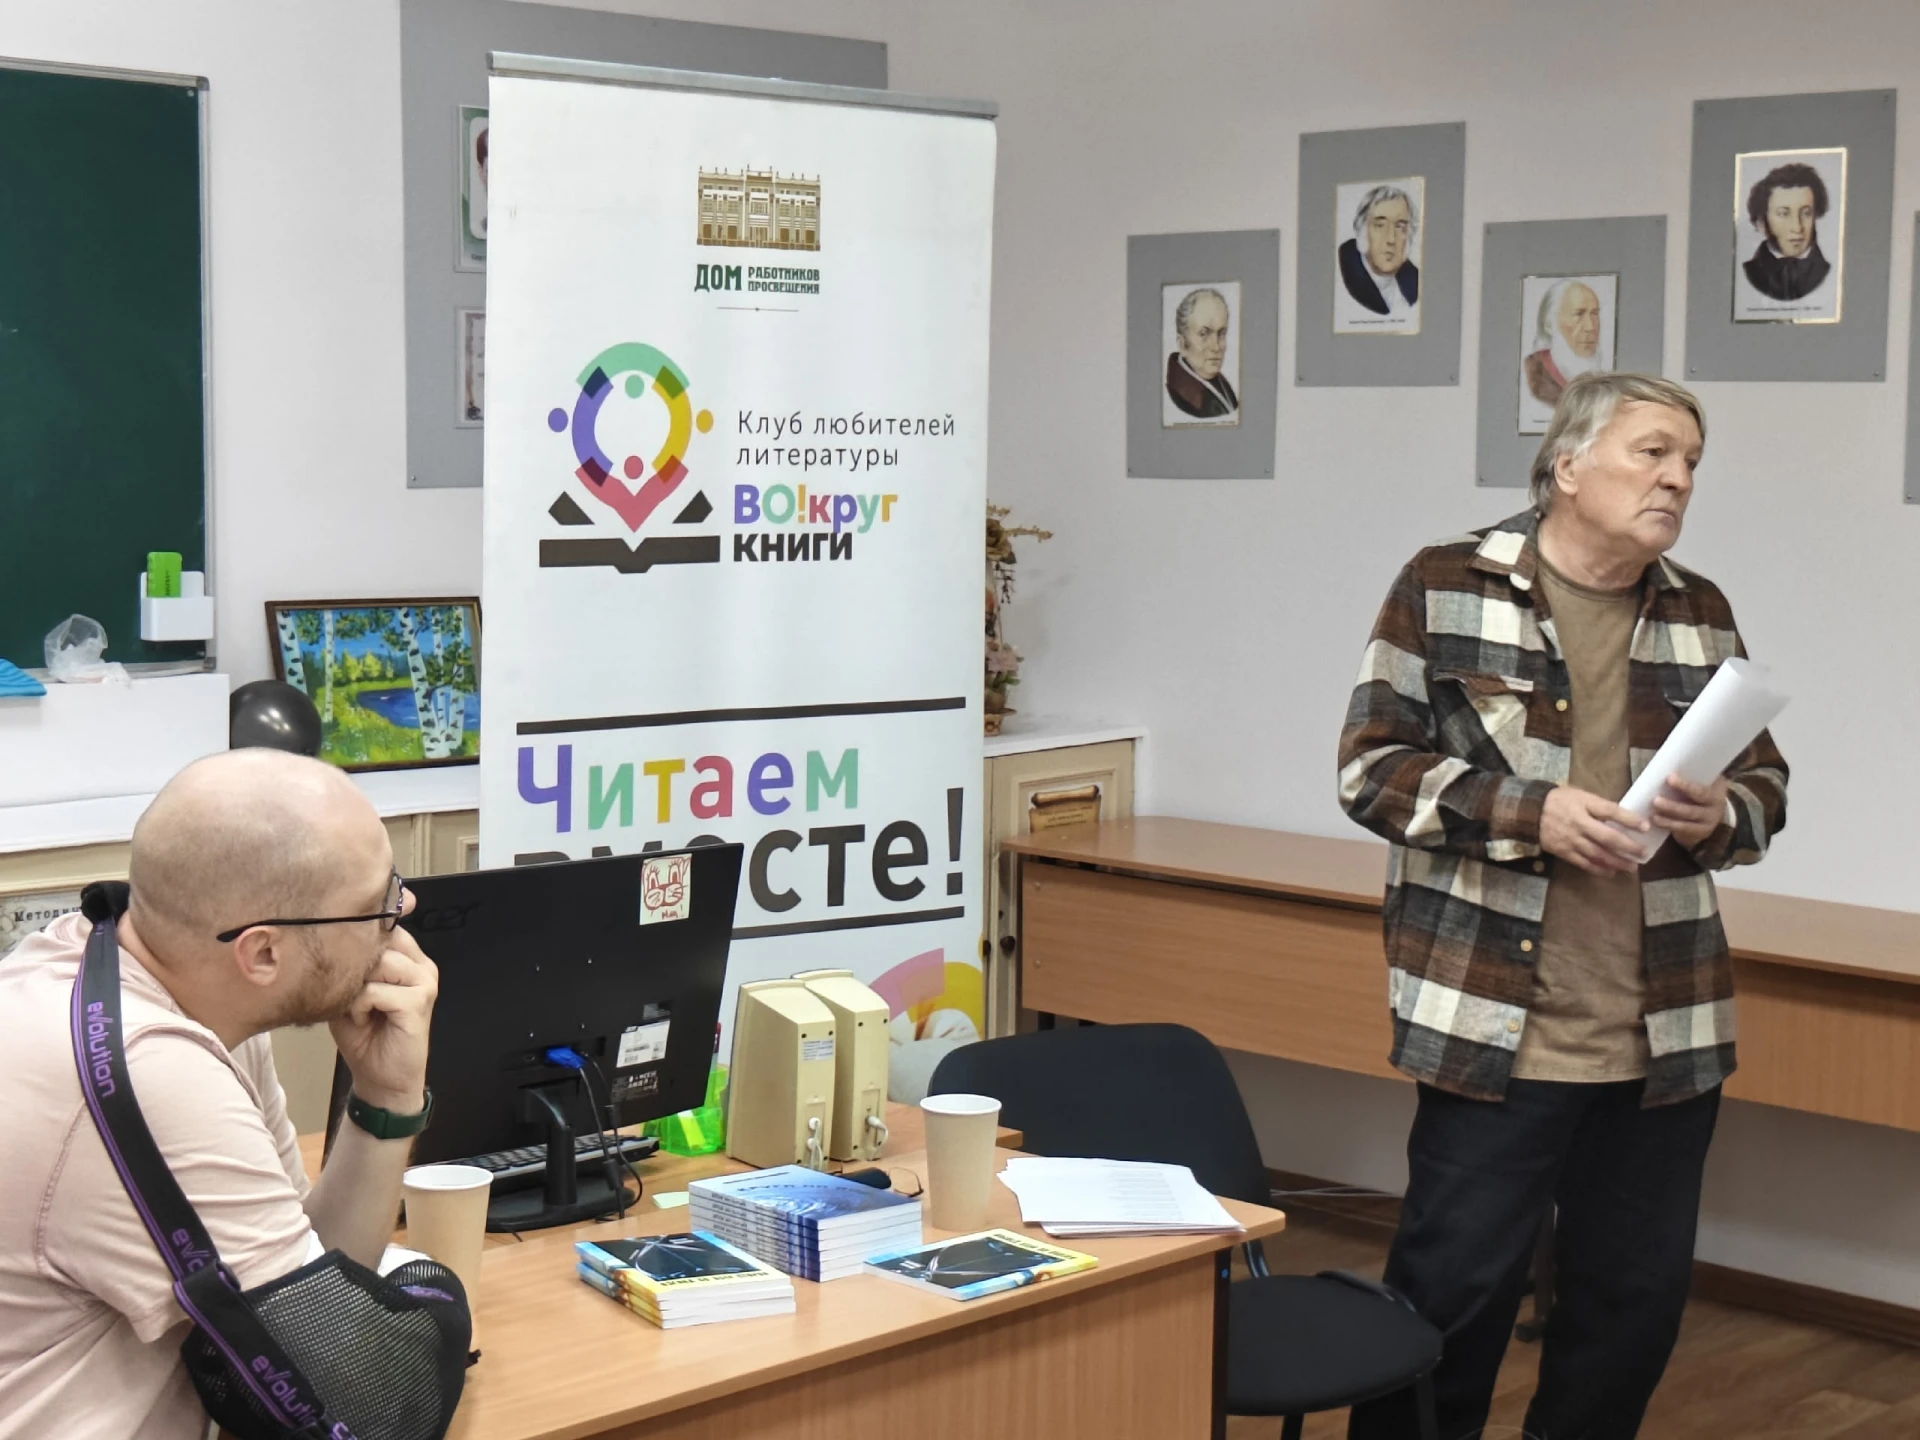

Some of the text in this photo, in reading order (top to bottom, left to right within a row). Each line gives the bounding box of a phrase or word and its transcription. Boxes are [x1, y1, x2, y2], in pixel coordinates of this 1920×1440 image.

[694, 264, 742, 293] ДОМ
[748, 266, 820, 282] РАБОТНИКОВ
[748, 280, 820, 295] ПРОСВЕЩЕНИЯ
[739, 411, 955, 439] Клуб любителей
[737, 447, 898, 472] литературы
[518, 744, 860, 833] Читаем
[87, 1001, 116, 1097] evolution
